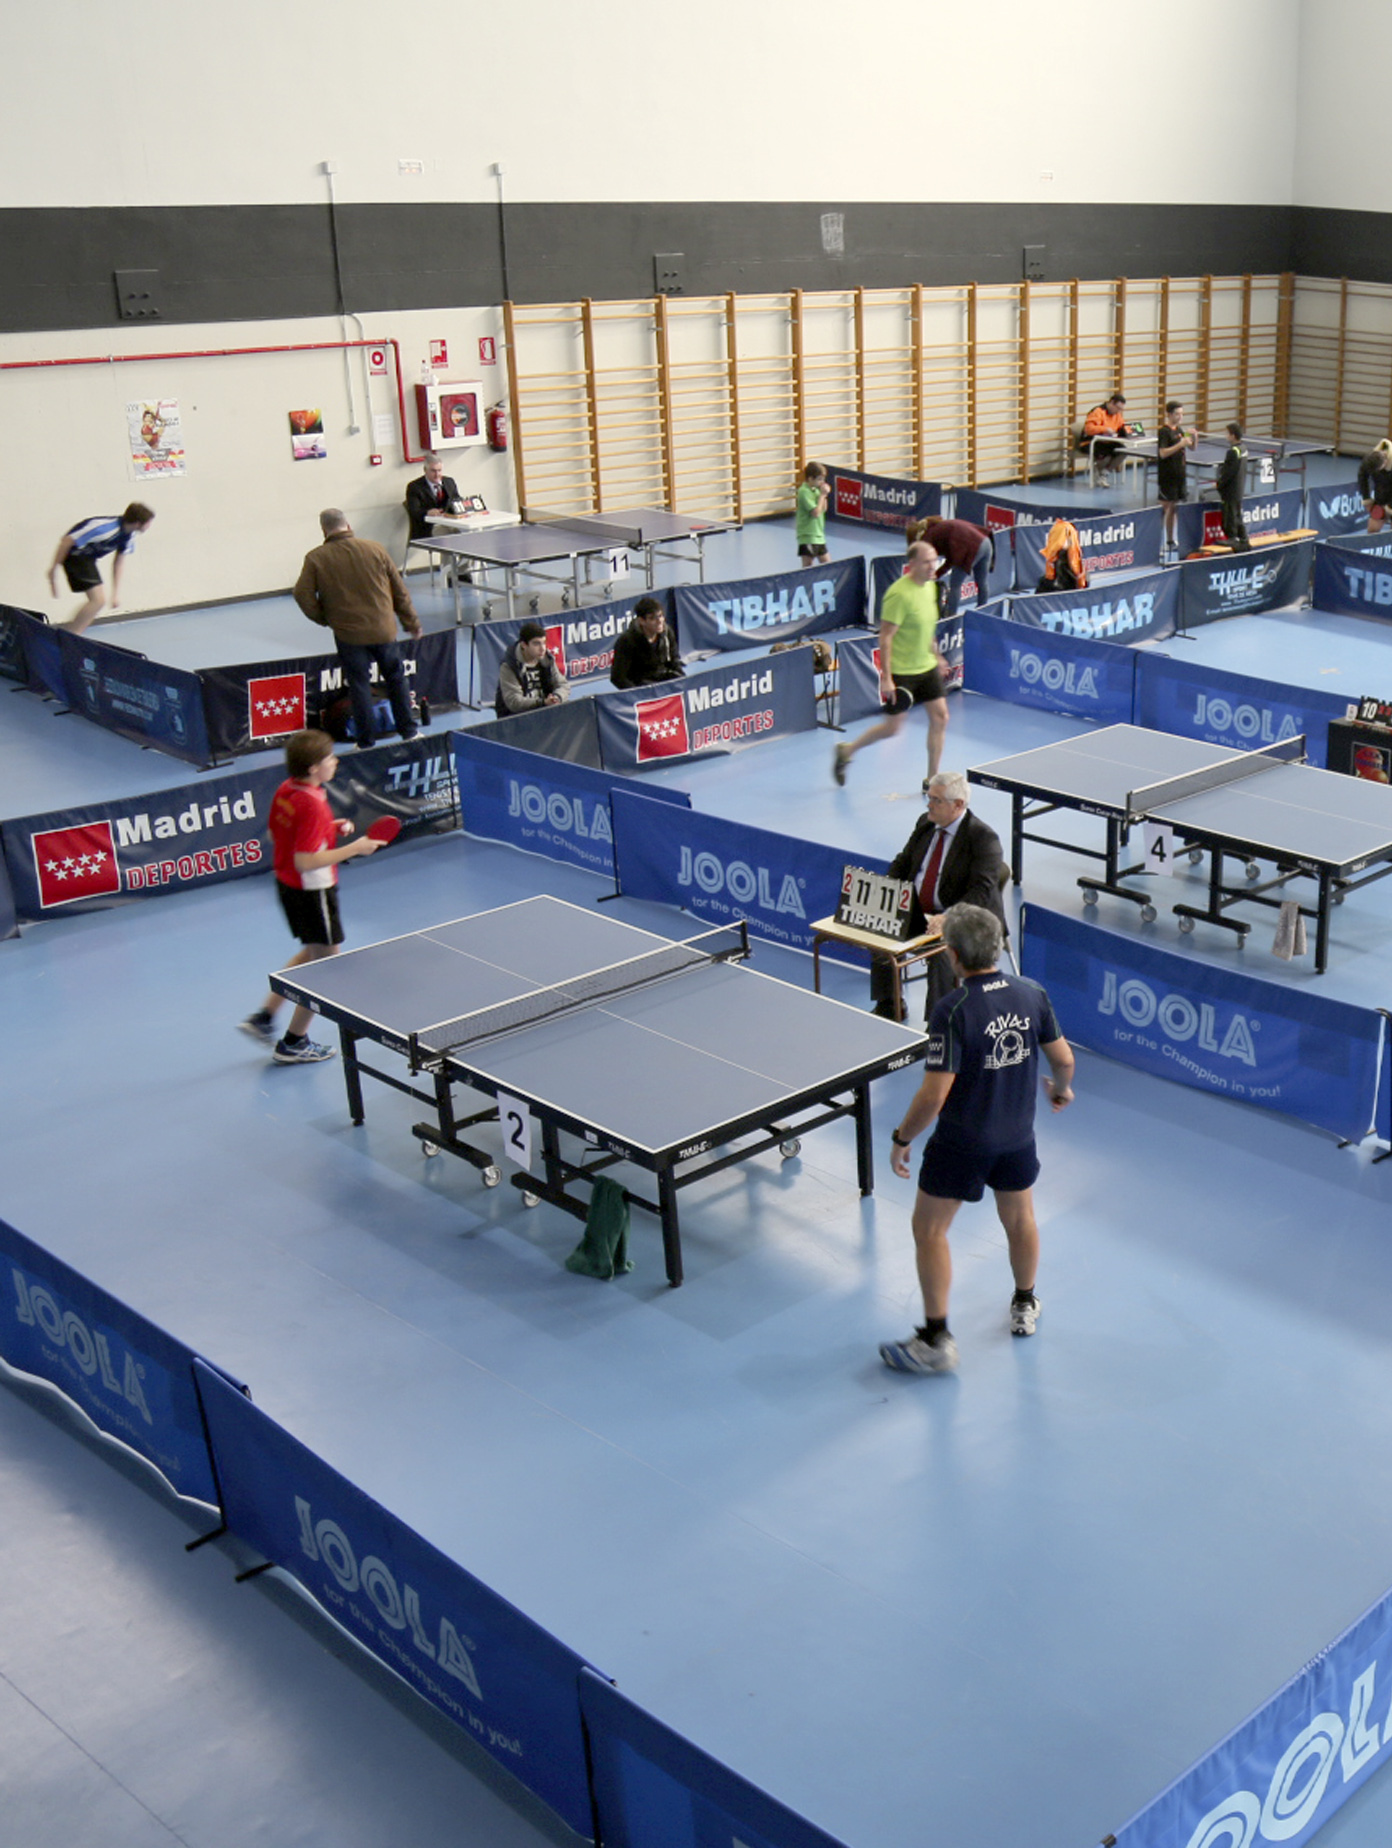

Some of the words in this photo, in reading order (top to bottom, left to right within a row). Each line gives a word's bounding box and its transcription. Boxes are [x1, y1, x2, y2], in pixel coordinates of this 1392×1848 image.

[863, 482, 917, 507] Madrid
[1241, 502, 1280, 523] adrid
[1079, 522, 1135, 547] Madrid
[609, 553, 630, 573] 11
[708, 579, 837, 636] TIBHAR
[689, 670, 774, 714] Madrid
[1009, 649, 1099, 699] JOOLA
[693, 709, 775, 751] DEPORTES
[1193, 693, 1298, 743] JOOLA
[1362, 701, 1378, 719] 10
[116, 790, 256, 847] Madrid
[508, 779, 613, 844] JOOLA
[126, 839, 262, 890] DEPORTES
[1150, 835, 1167, 863] 4
[677, 845, 807, 920] JOOLA
[844, 873, 851, 893] 2
[857, 879, 871, 905] 11
[880, 886, 895, 913] 11
[900, 889, 910, 910] 2
[710, 899, 730, 914] the
[731, 907, 789, 940] Champion
[791, 932, 802, 943] in
[840, 904, 902, 937] TIBHAR
[984, 1013, 1031, 1039] RIVAS
[1098, 970, 1257, 1068] JOOLA
[1114, 1028, 1133, 1041] for
[1136, 1033, 1157, 1050] the
[1161, 1044, 1228, 1088] Champion
[1231, 1080, 1245, 1094] in
[1249, 1085, 1281, 1098] you!
[507, 1110, 526, 1151] 2
[12, 1267, 154, 1426] JOOLA
[294, 1494, 483, 1701] JOOLA
[377, 1628, 464, 1719] Champion
[468, 1710, 484, 1734] in
[488, 1728, 524, 1757] you!
